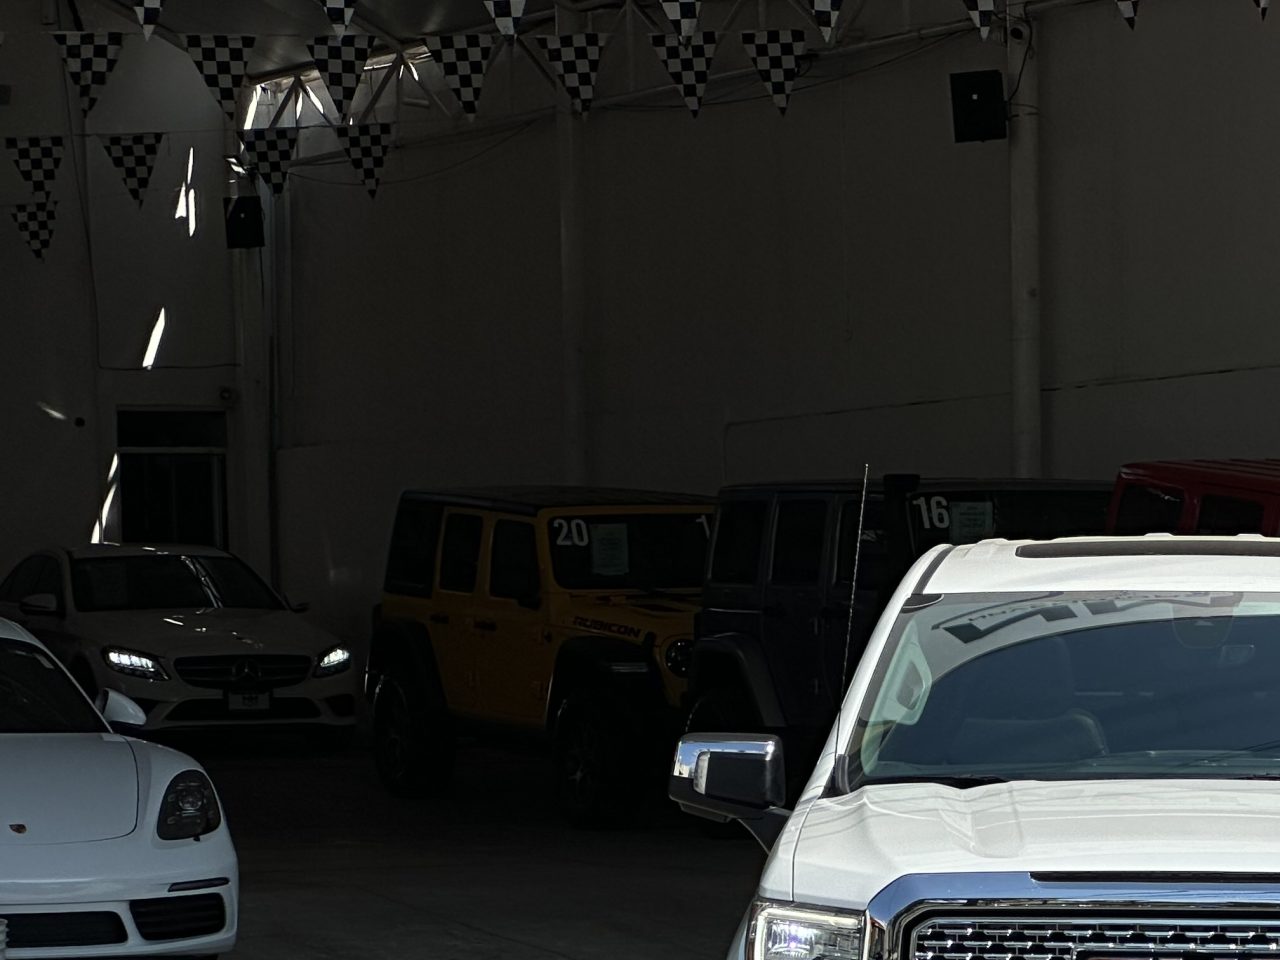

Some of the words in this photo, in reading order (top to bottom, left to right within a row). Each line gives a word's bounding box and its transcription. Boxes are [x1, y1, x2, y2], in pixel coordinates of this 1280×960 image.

[912, 496, 950, 528] 16
[553, 518, 590, 547] 20
[572, 615, 642, 638] RUBICON
